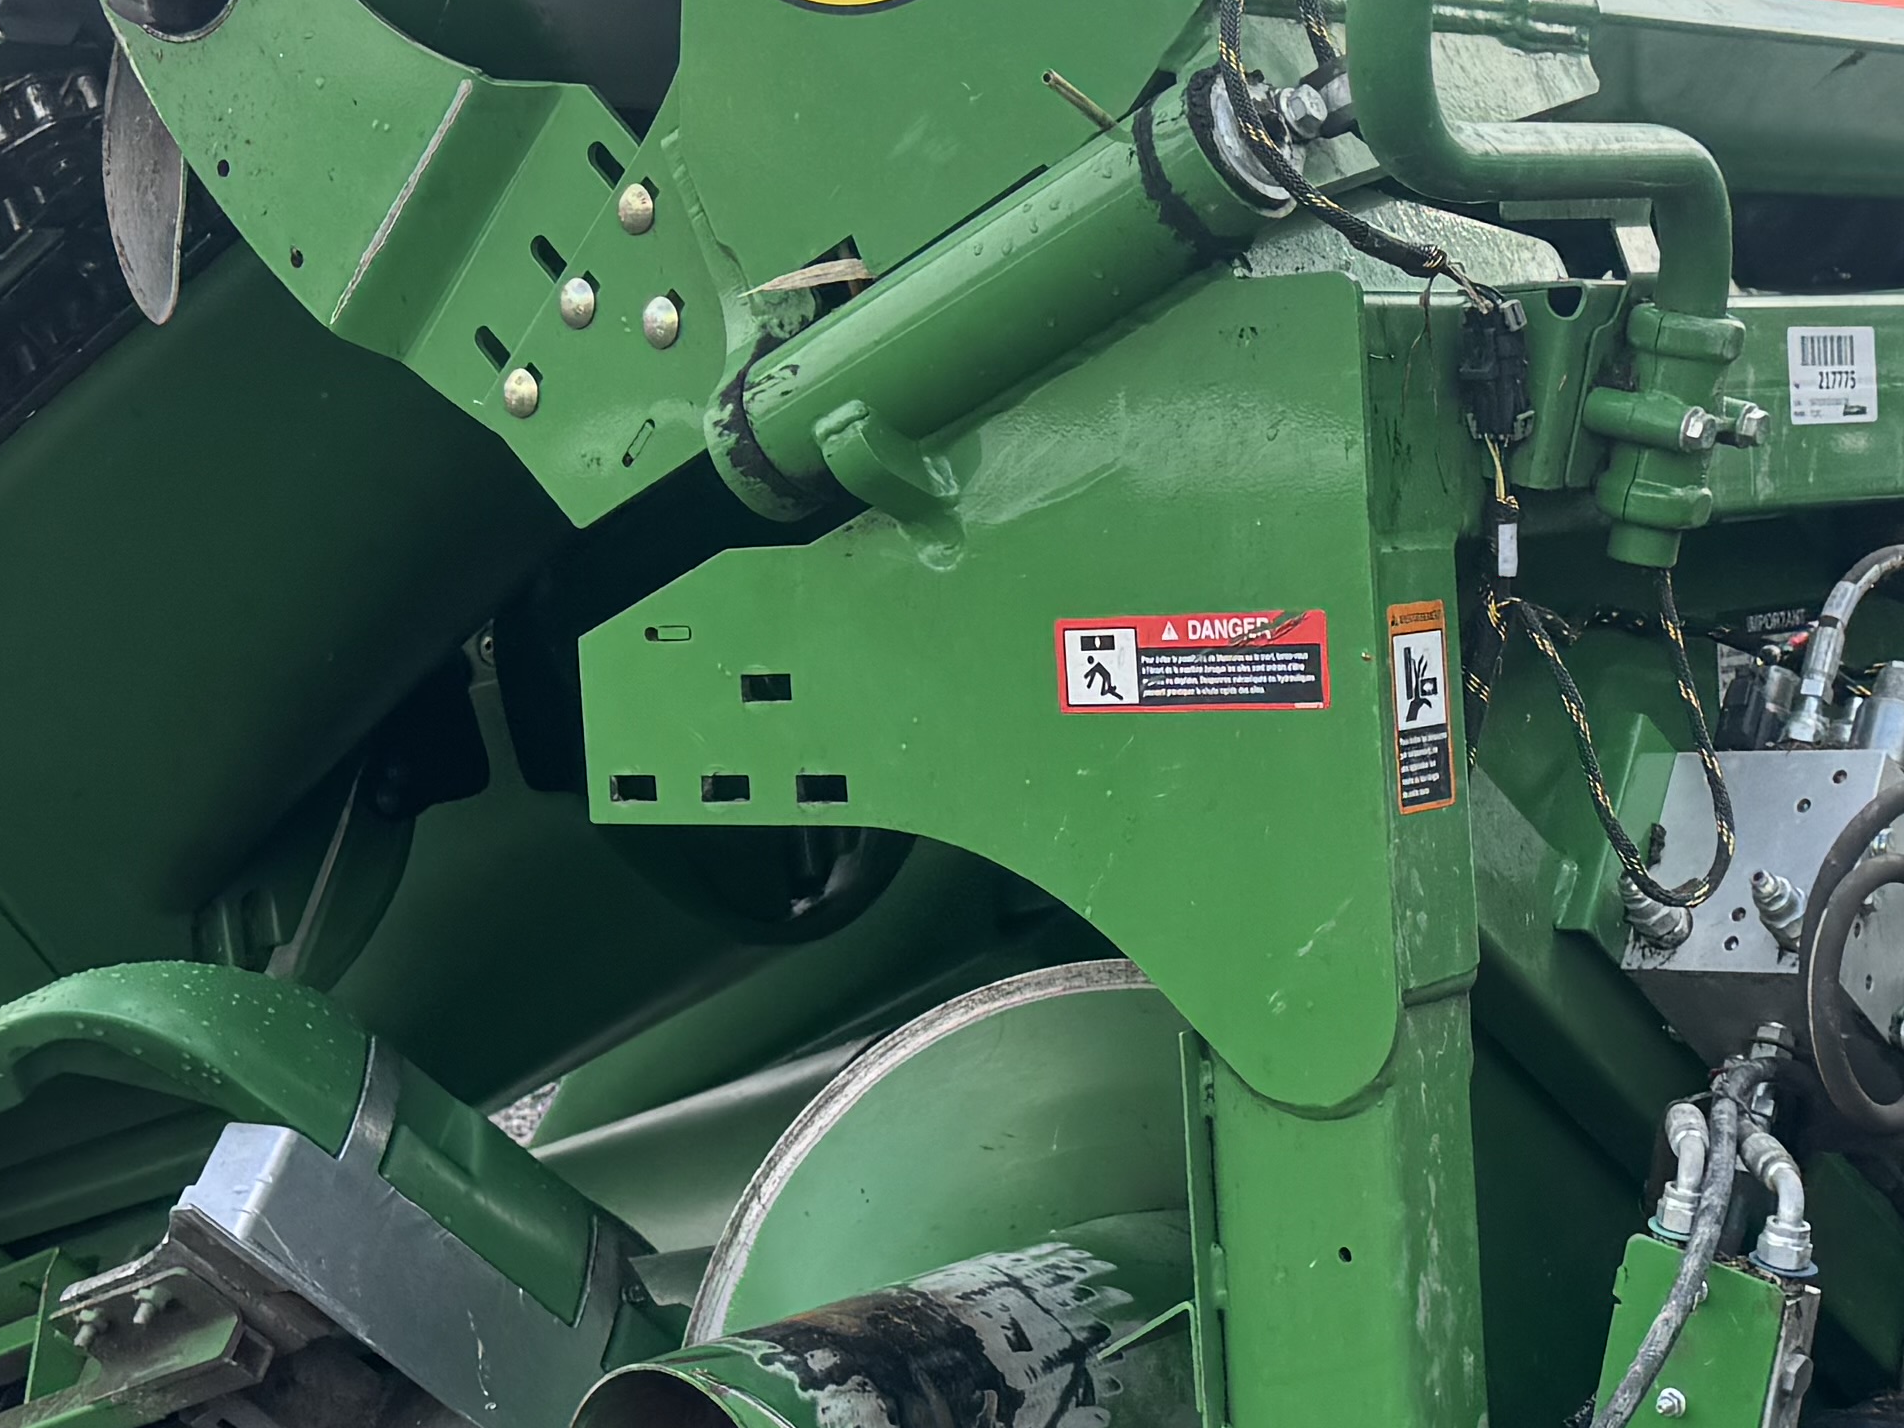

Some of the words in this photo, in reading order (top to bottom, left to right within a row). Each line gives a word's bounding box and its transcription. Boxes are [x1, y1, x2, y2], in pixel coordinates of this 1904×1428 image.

[1818, 370, 1856, 390] 217775
[1187, 617, 1272, 641] DANGER
[1745, 608, 1807, 633] IMPORTANT
